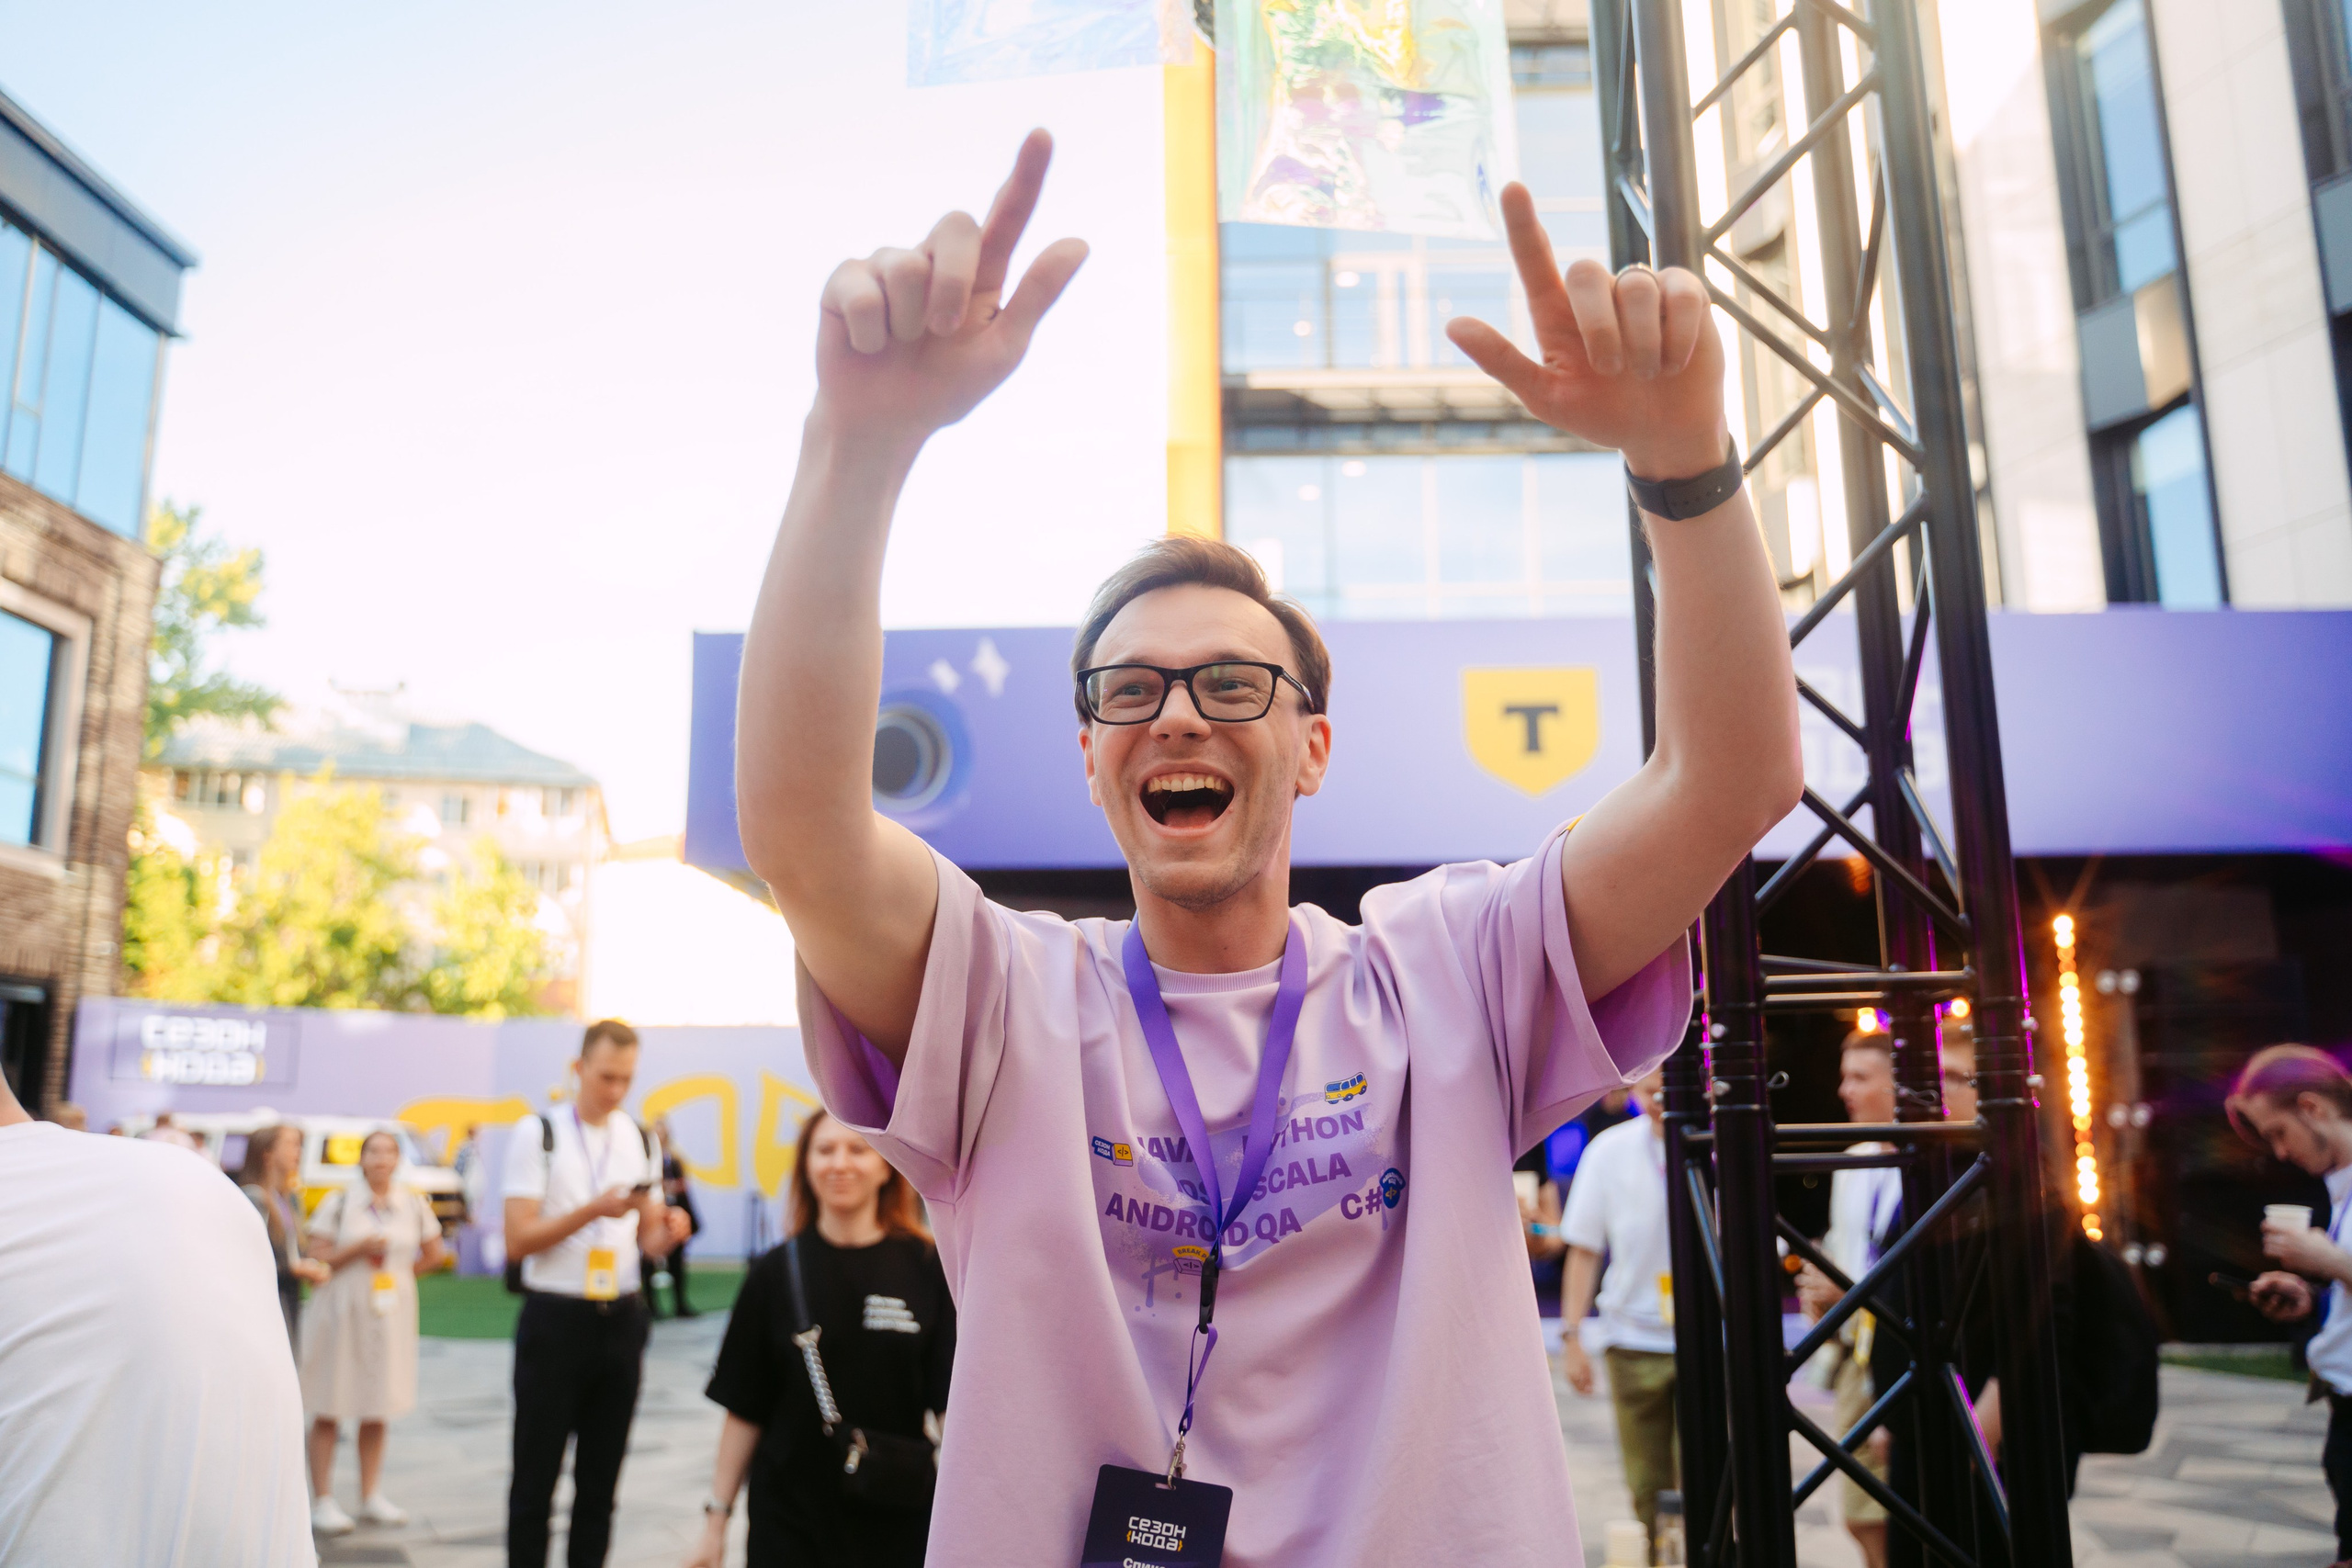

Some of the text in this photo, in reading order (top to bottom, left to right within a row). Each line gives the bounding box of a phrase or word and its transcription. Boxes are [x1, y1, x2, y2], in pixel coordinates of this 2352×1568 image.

[1251, 1152, 1352, 1201] SCALA
[1255, 1207, 1303, 1244] QA
[1340, 1186, 1382, 1220] C#
